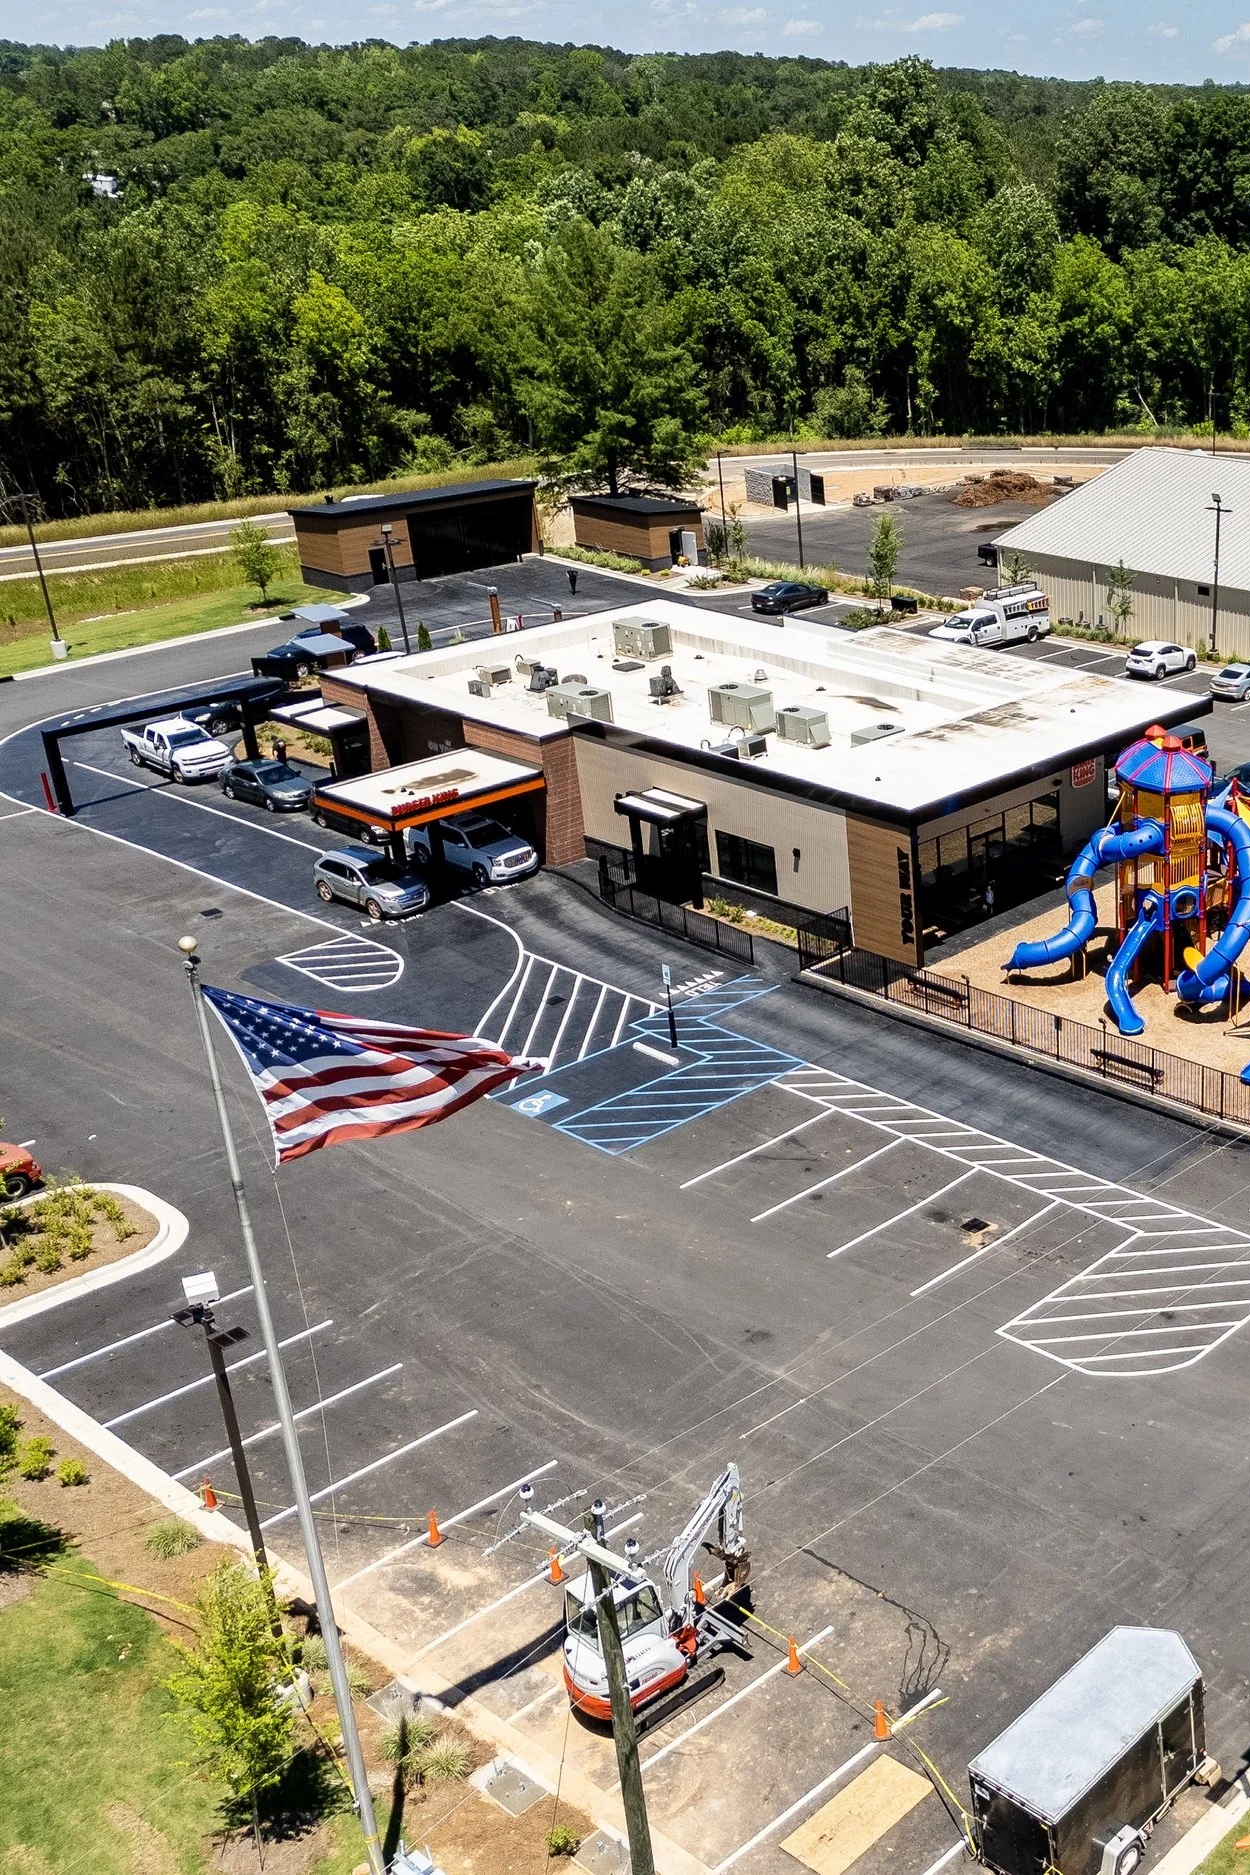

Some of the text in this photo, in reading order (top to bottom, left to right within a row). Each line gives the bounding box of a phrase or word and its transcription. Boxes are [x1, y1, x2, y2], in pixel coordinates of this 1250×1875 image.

[391, 797, 432, 816] BURGER
[897, 846, 914, 945] YOUR WAY
